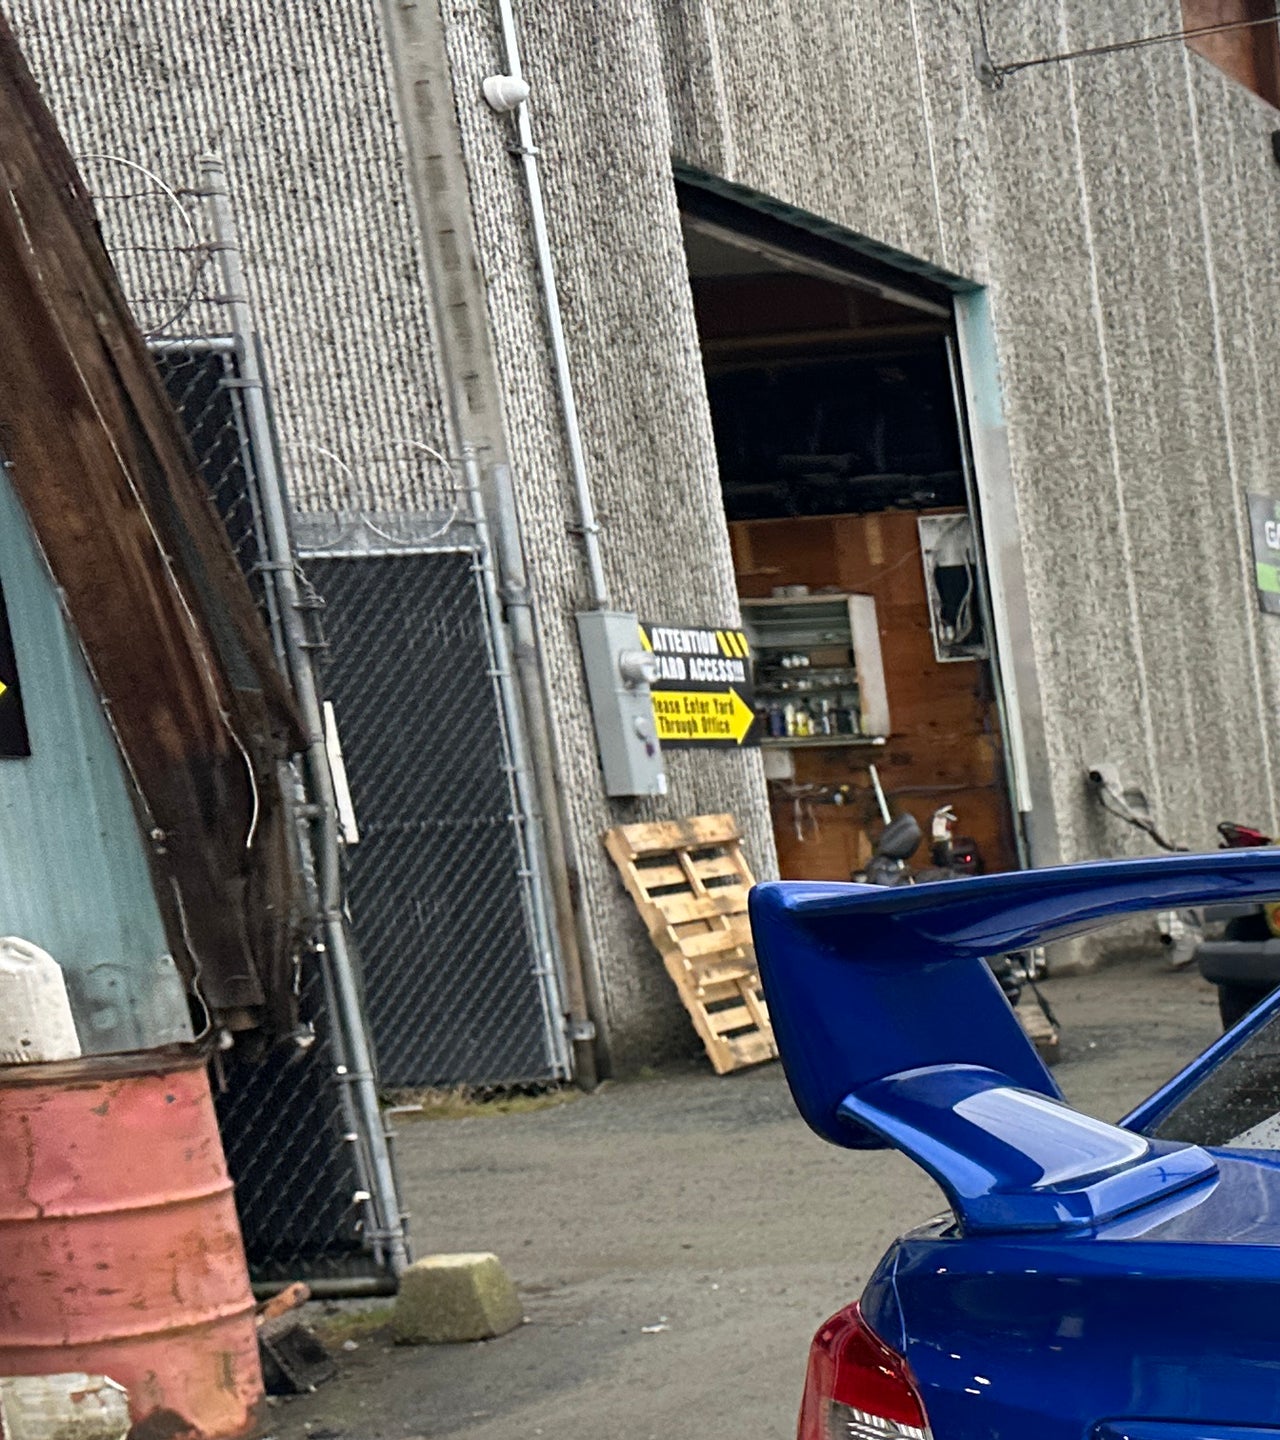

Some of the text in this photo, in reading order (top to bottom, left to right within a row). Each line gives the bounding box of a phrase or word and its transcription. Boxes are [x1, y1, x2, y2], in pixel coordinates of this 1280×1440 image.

[652, 627, 719, 654] ATTENTION
[653, 697, 735, 715] lease Enter Yard
[659, 717, 730, 737] Through Office
